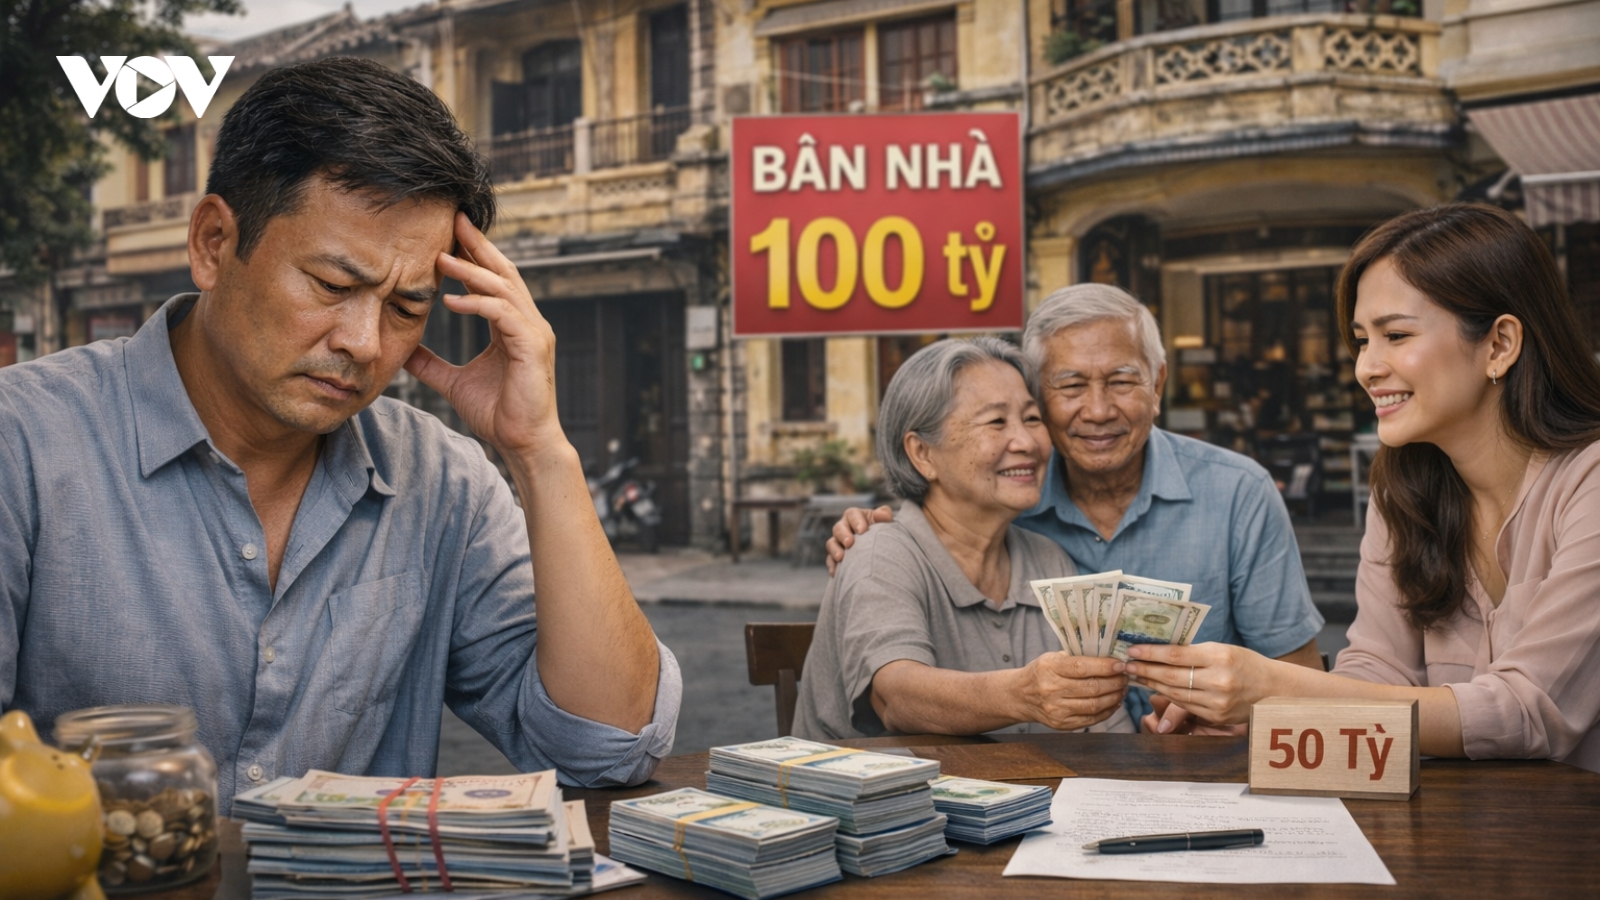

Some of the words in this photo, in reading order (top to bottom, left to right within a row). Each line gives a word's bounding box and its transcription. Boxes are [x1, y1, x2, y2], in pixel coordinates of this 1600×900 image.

[752, 132, 866, 192] BÂN
[886, 128, 1003, 190] NHÀ
[750, 216, 924, 310] 100
[943, 221, 1006, 312] tỷ
[1268, 728, 1325, 770] 50
